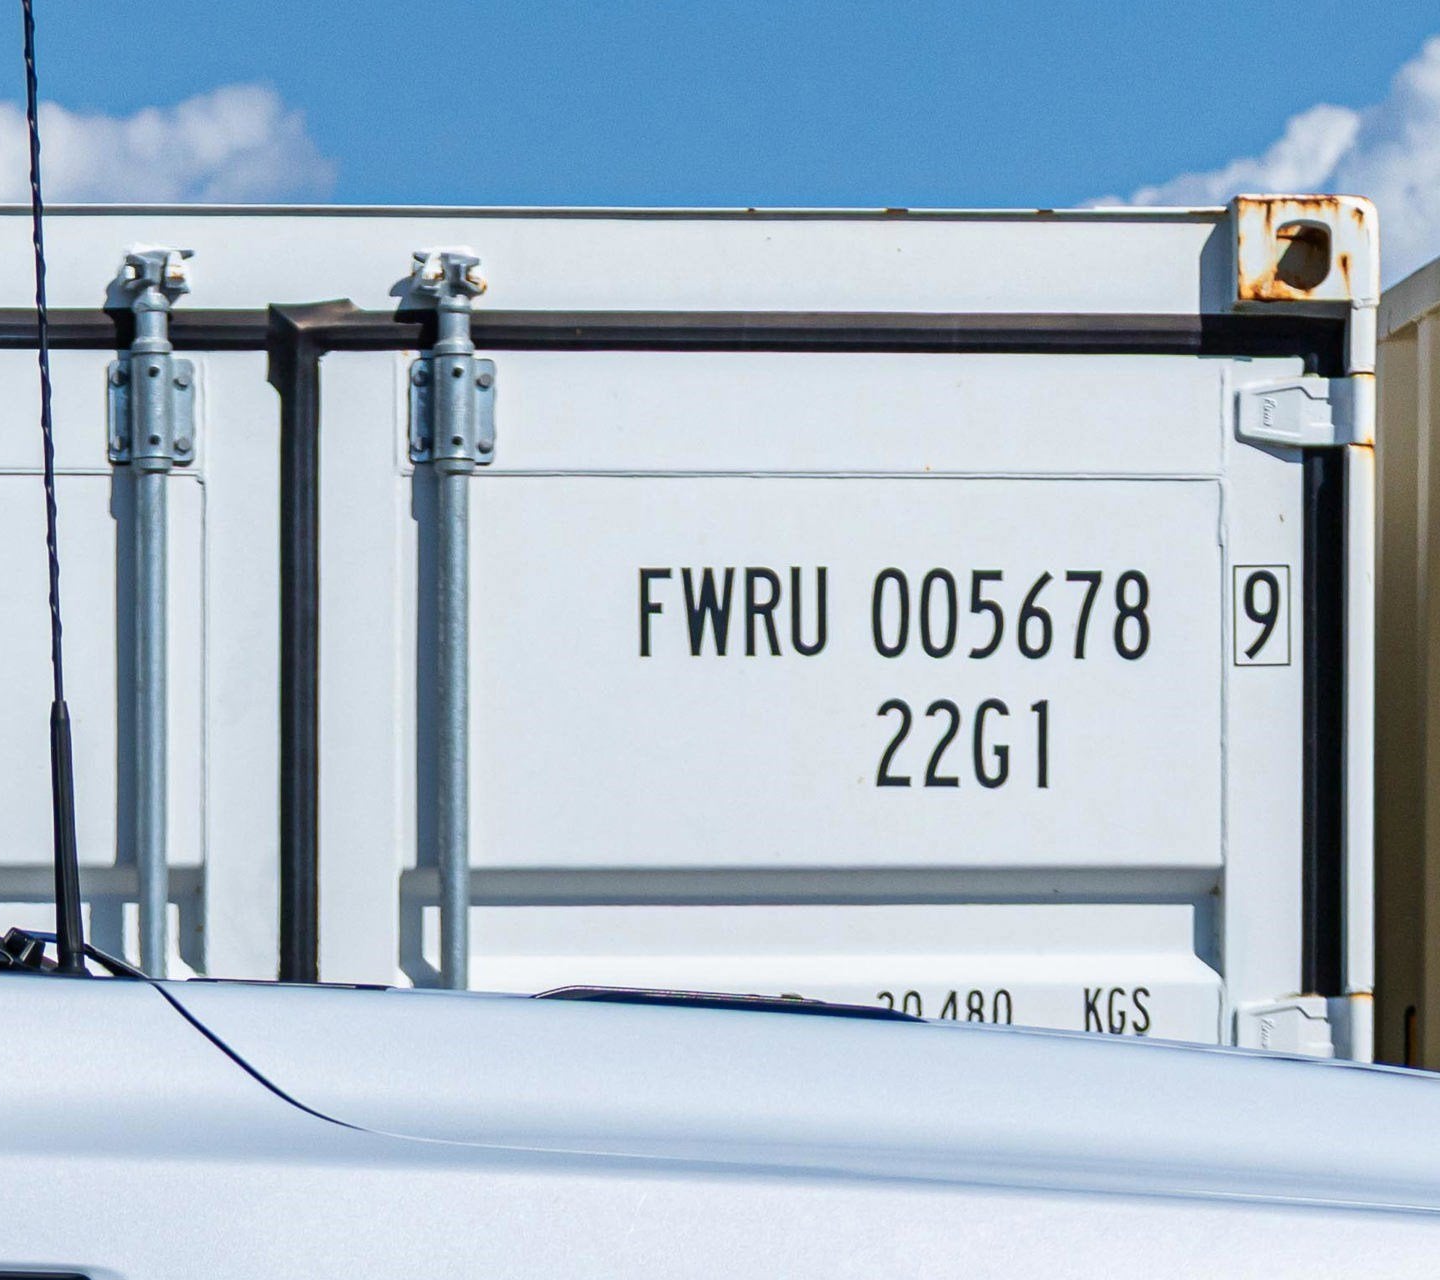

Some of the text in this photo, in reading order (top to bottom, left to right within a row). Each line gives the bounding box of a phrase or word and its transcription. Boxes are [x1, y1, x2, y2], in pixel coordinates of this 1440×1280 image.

[638, 567, 1281, 661] FWRU 005678 9
[875, 698, 1049, 788] 22G1
[1083, 987, 1150, 1036] KGS
